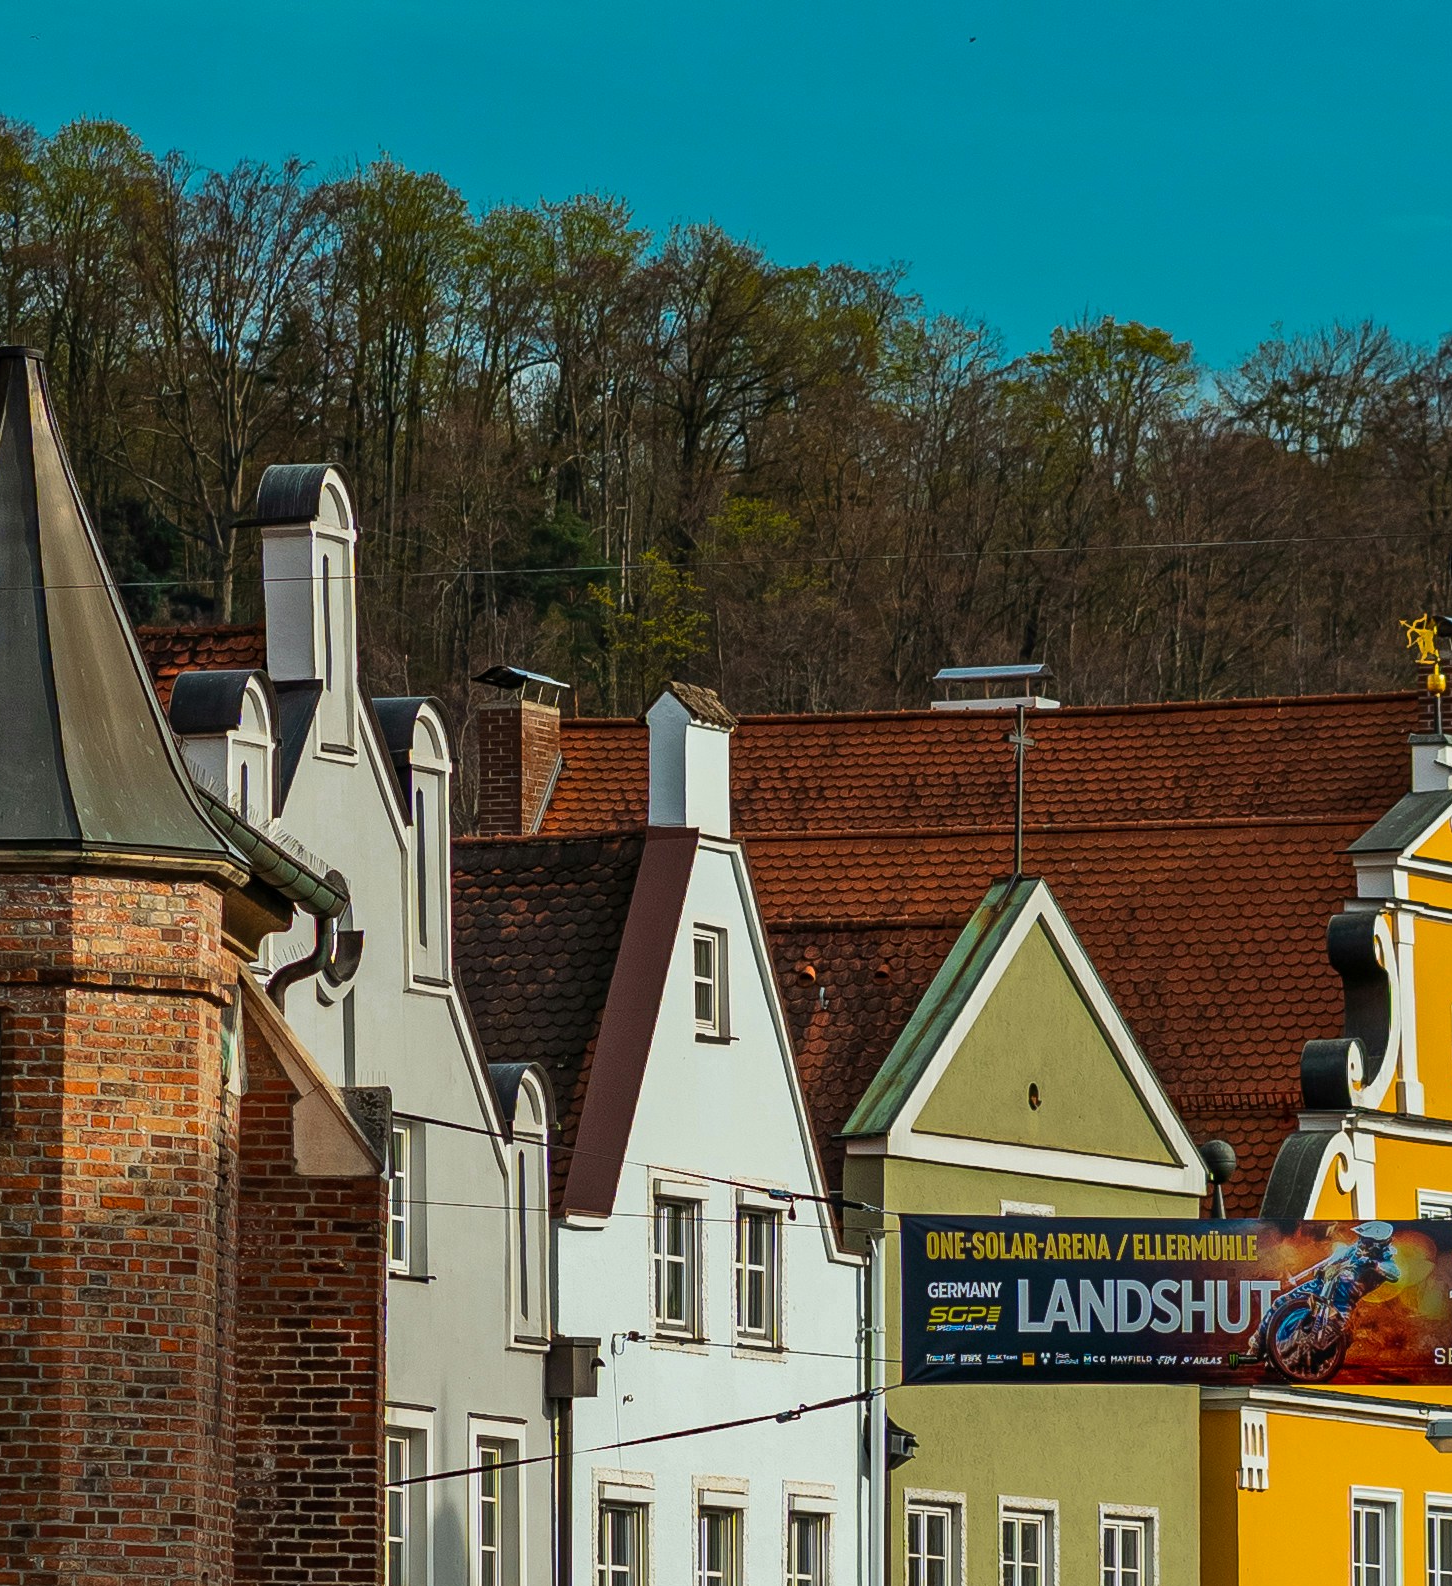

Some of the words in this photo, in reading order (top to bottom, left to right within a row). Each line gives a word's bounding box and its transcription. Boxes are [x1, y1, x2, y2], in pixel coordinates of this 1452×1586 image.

[926, 1231, 1111, 1262] ONE-SOLAR-ARENA
[1132, 1230, 1259, 1262] ELLERMÜHLE
[927, 1281, 1003, 1299] GERMANY
[1017, 1278, 1282, 1334] LANDSHUT
